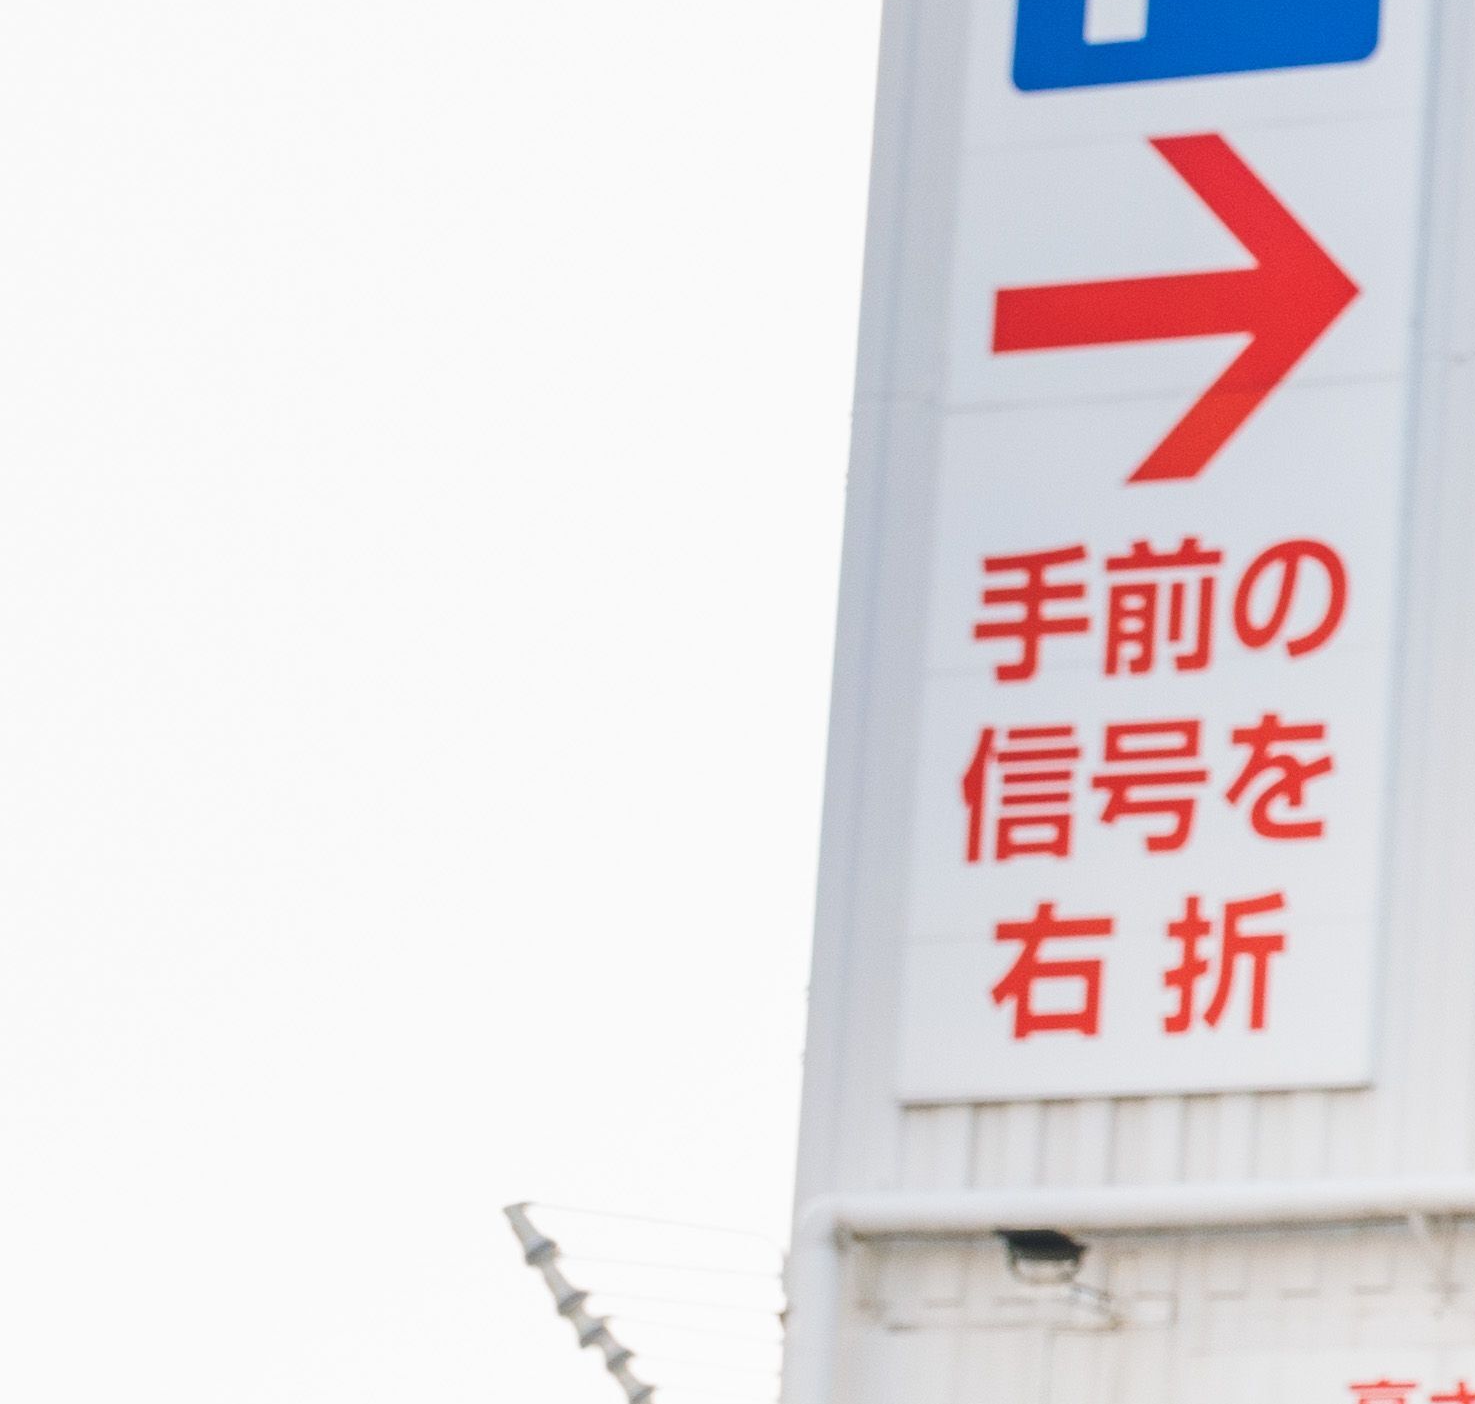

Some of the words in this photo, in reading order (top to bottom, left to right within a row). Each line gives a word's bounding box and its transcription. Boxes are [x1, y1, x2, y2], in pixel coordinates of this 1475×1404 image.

[972, 534, 1350, 686] 手前の
[959, 710, 1336, 866] 信号を
